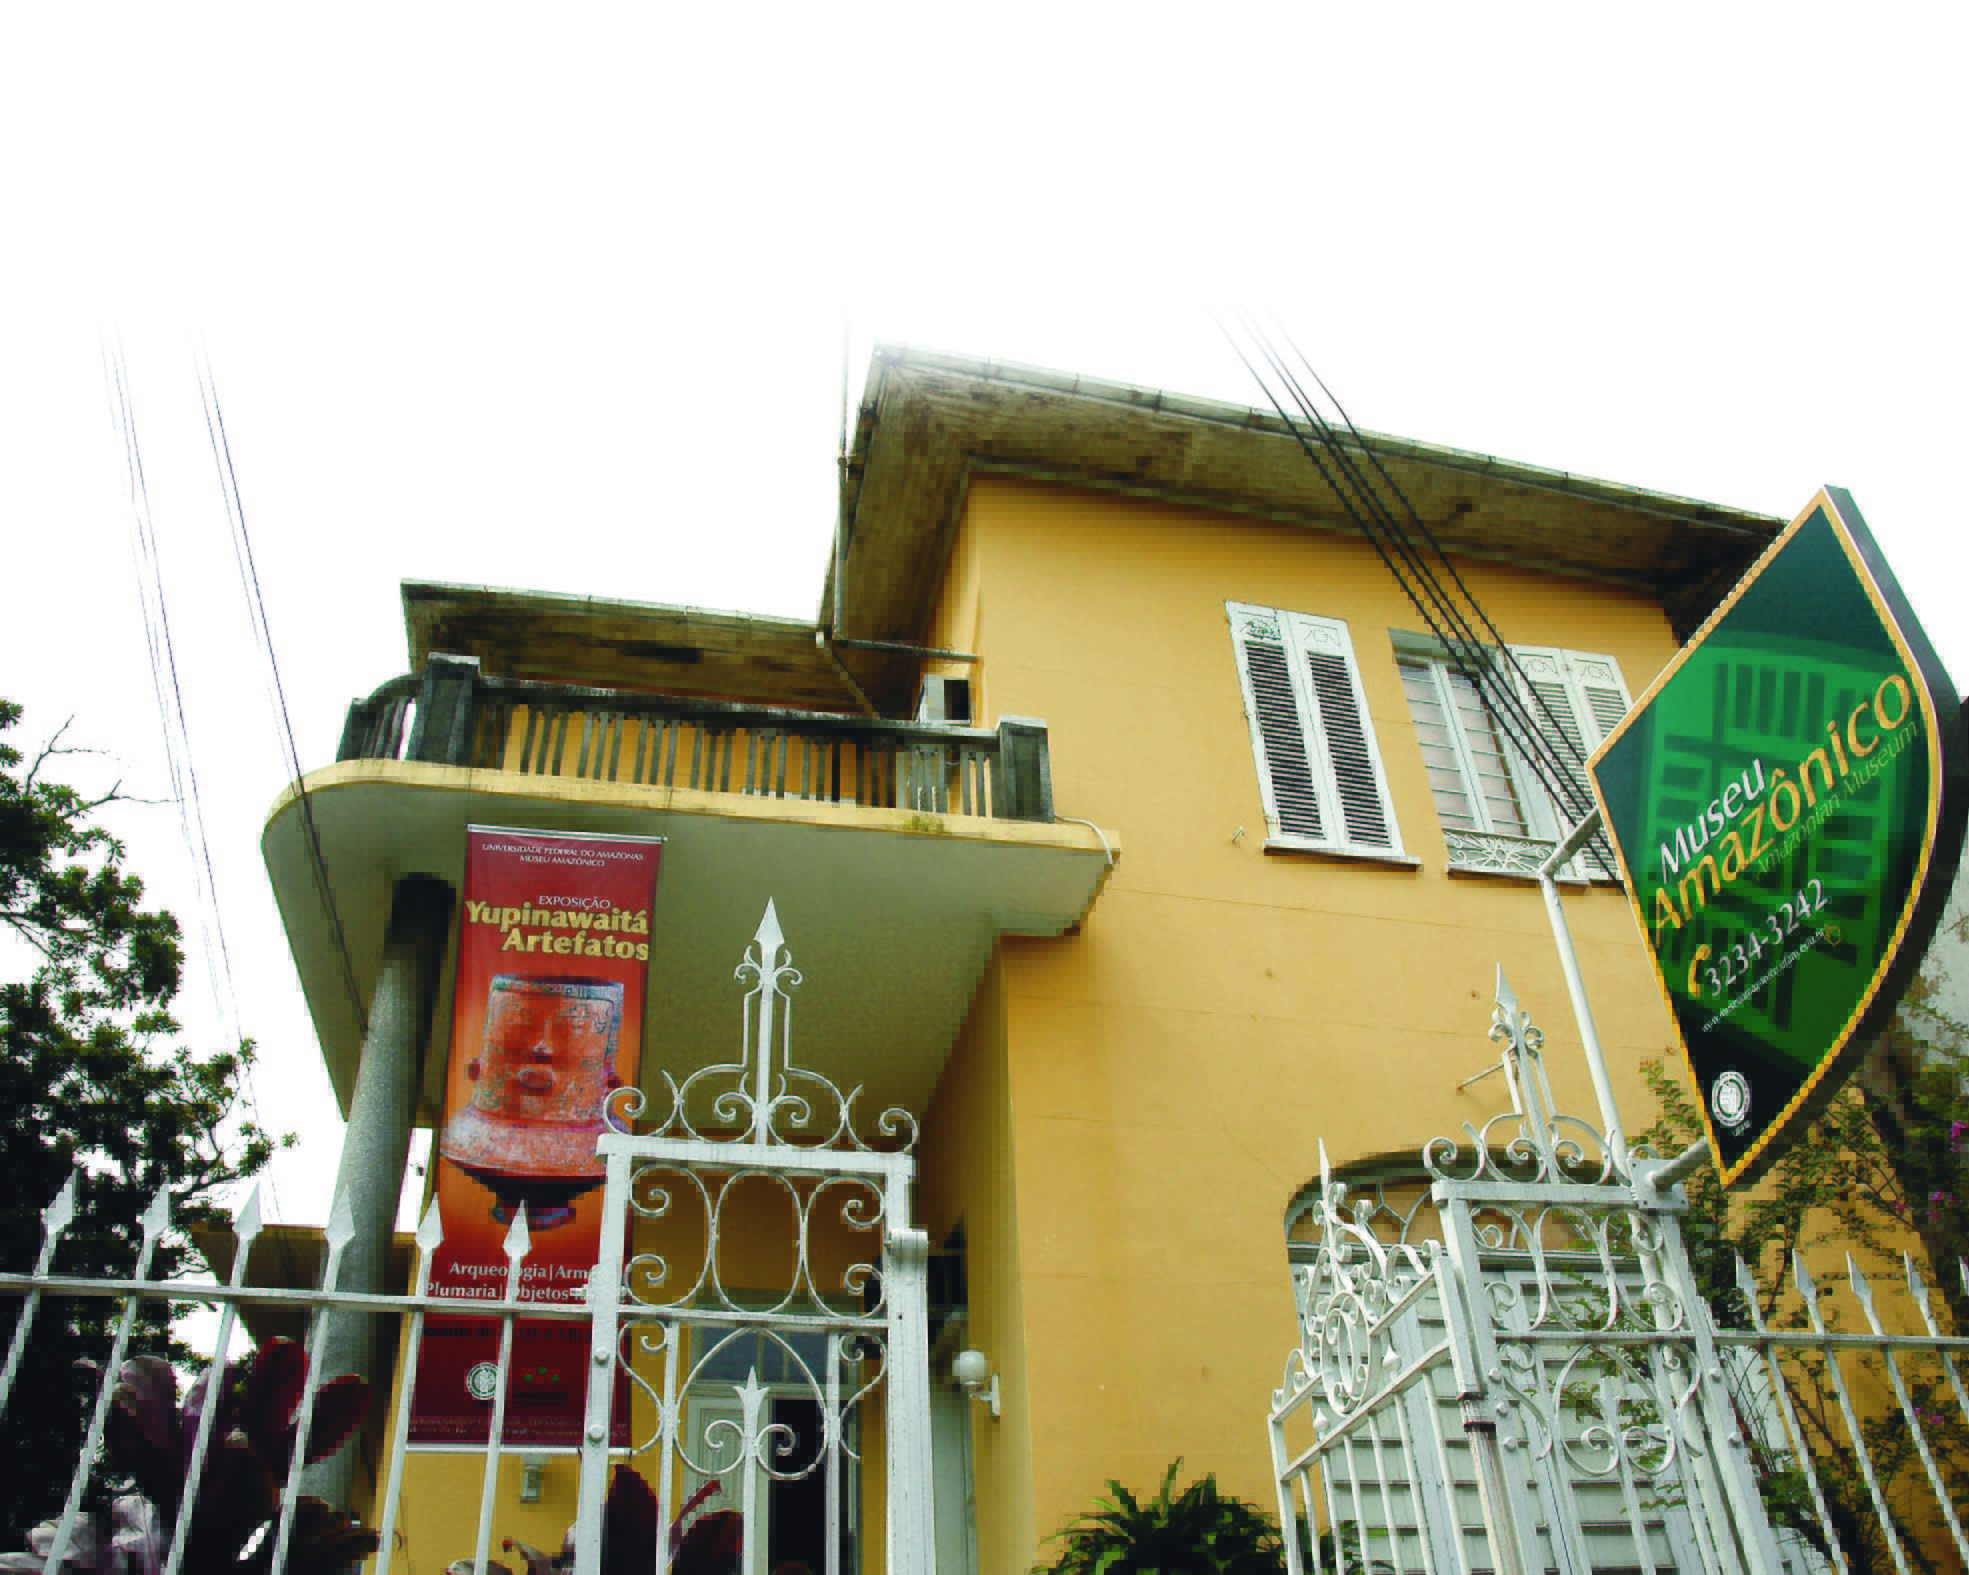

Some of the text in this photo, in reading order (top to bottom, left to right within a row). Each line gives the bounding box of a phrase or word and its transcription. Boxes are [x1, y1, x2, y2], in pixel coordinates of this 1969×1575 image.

[1654, 674, 1911, 948] Amazônico
[1756, 721, 1917, 881] Amazonian Museum
[1660, 758, 1765, 884] Museu
[482, 843, 644, 860] UNIVERSIDADE FEDERAL DO AMAZONAS
[520, 855, 605, 867] MUSEU AMAZÔNICO
[465, 901, 649, 935] Yupinawaitá
[538, 895, 611, 910] EXPOSIÇÃO
[501, 928, 649, 961] Artefatos
[1706, 878, 1828, 997] 3234-3242
[449, 1261, 547, 1281] Arqueogia
[426, 1281, 497, 1297] Plumaria
[516, 1284, 569, 1302] bjetos
